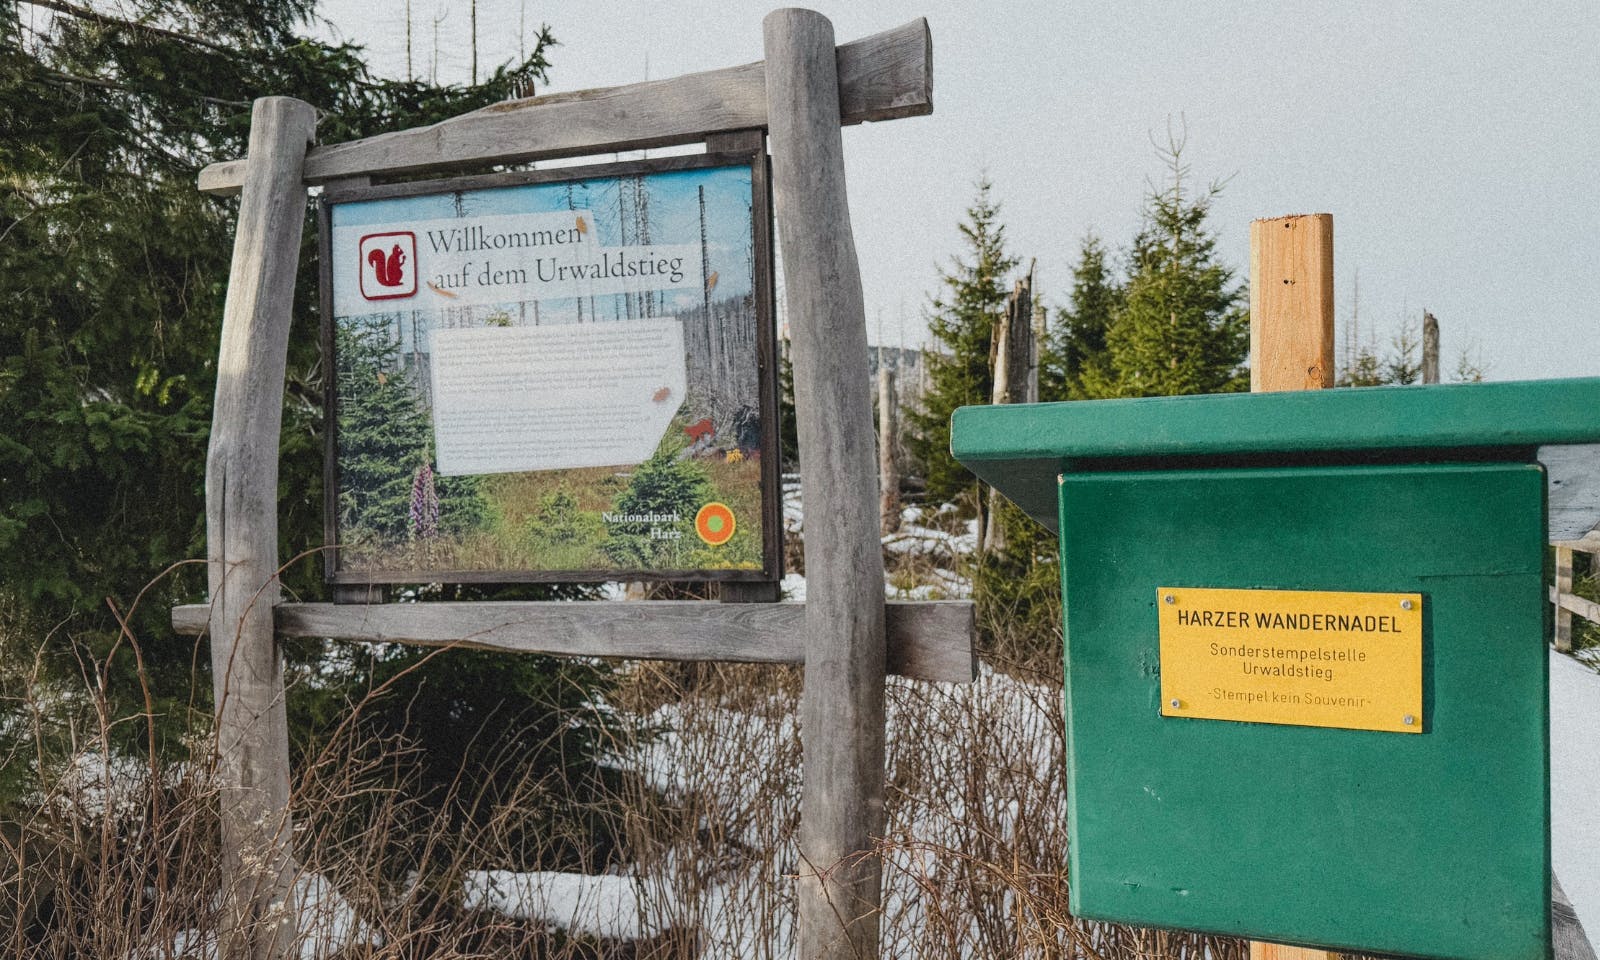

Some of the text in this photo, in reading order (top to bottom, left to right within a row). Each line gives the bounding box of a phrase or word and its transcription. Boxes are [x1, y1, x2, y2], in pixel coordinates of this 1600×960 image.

[427, 224, 583, 253] Willkommen
[434, 251, 684, 289] auf dem Urwaldstieg
[602, 510, 681, 525] Nationalpark
[650, 526, 681, 540] Harz
[1178, 609, 1402, 633] HARZER WANDERNADEL
[1210, 642, 1367, 662] Sonderstempelstelle
[1243, 661, 1333, 682] Urwaldstieg
[1272, 691, 1301, 704] kein
